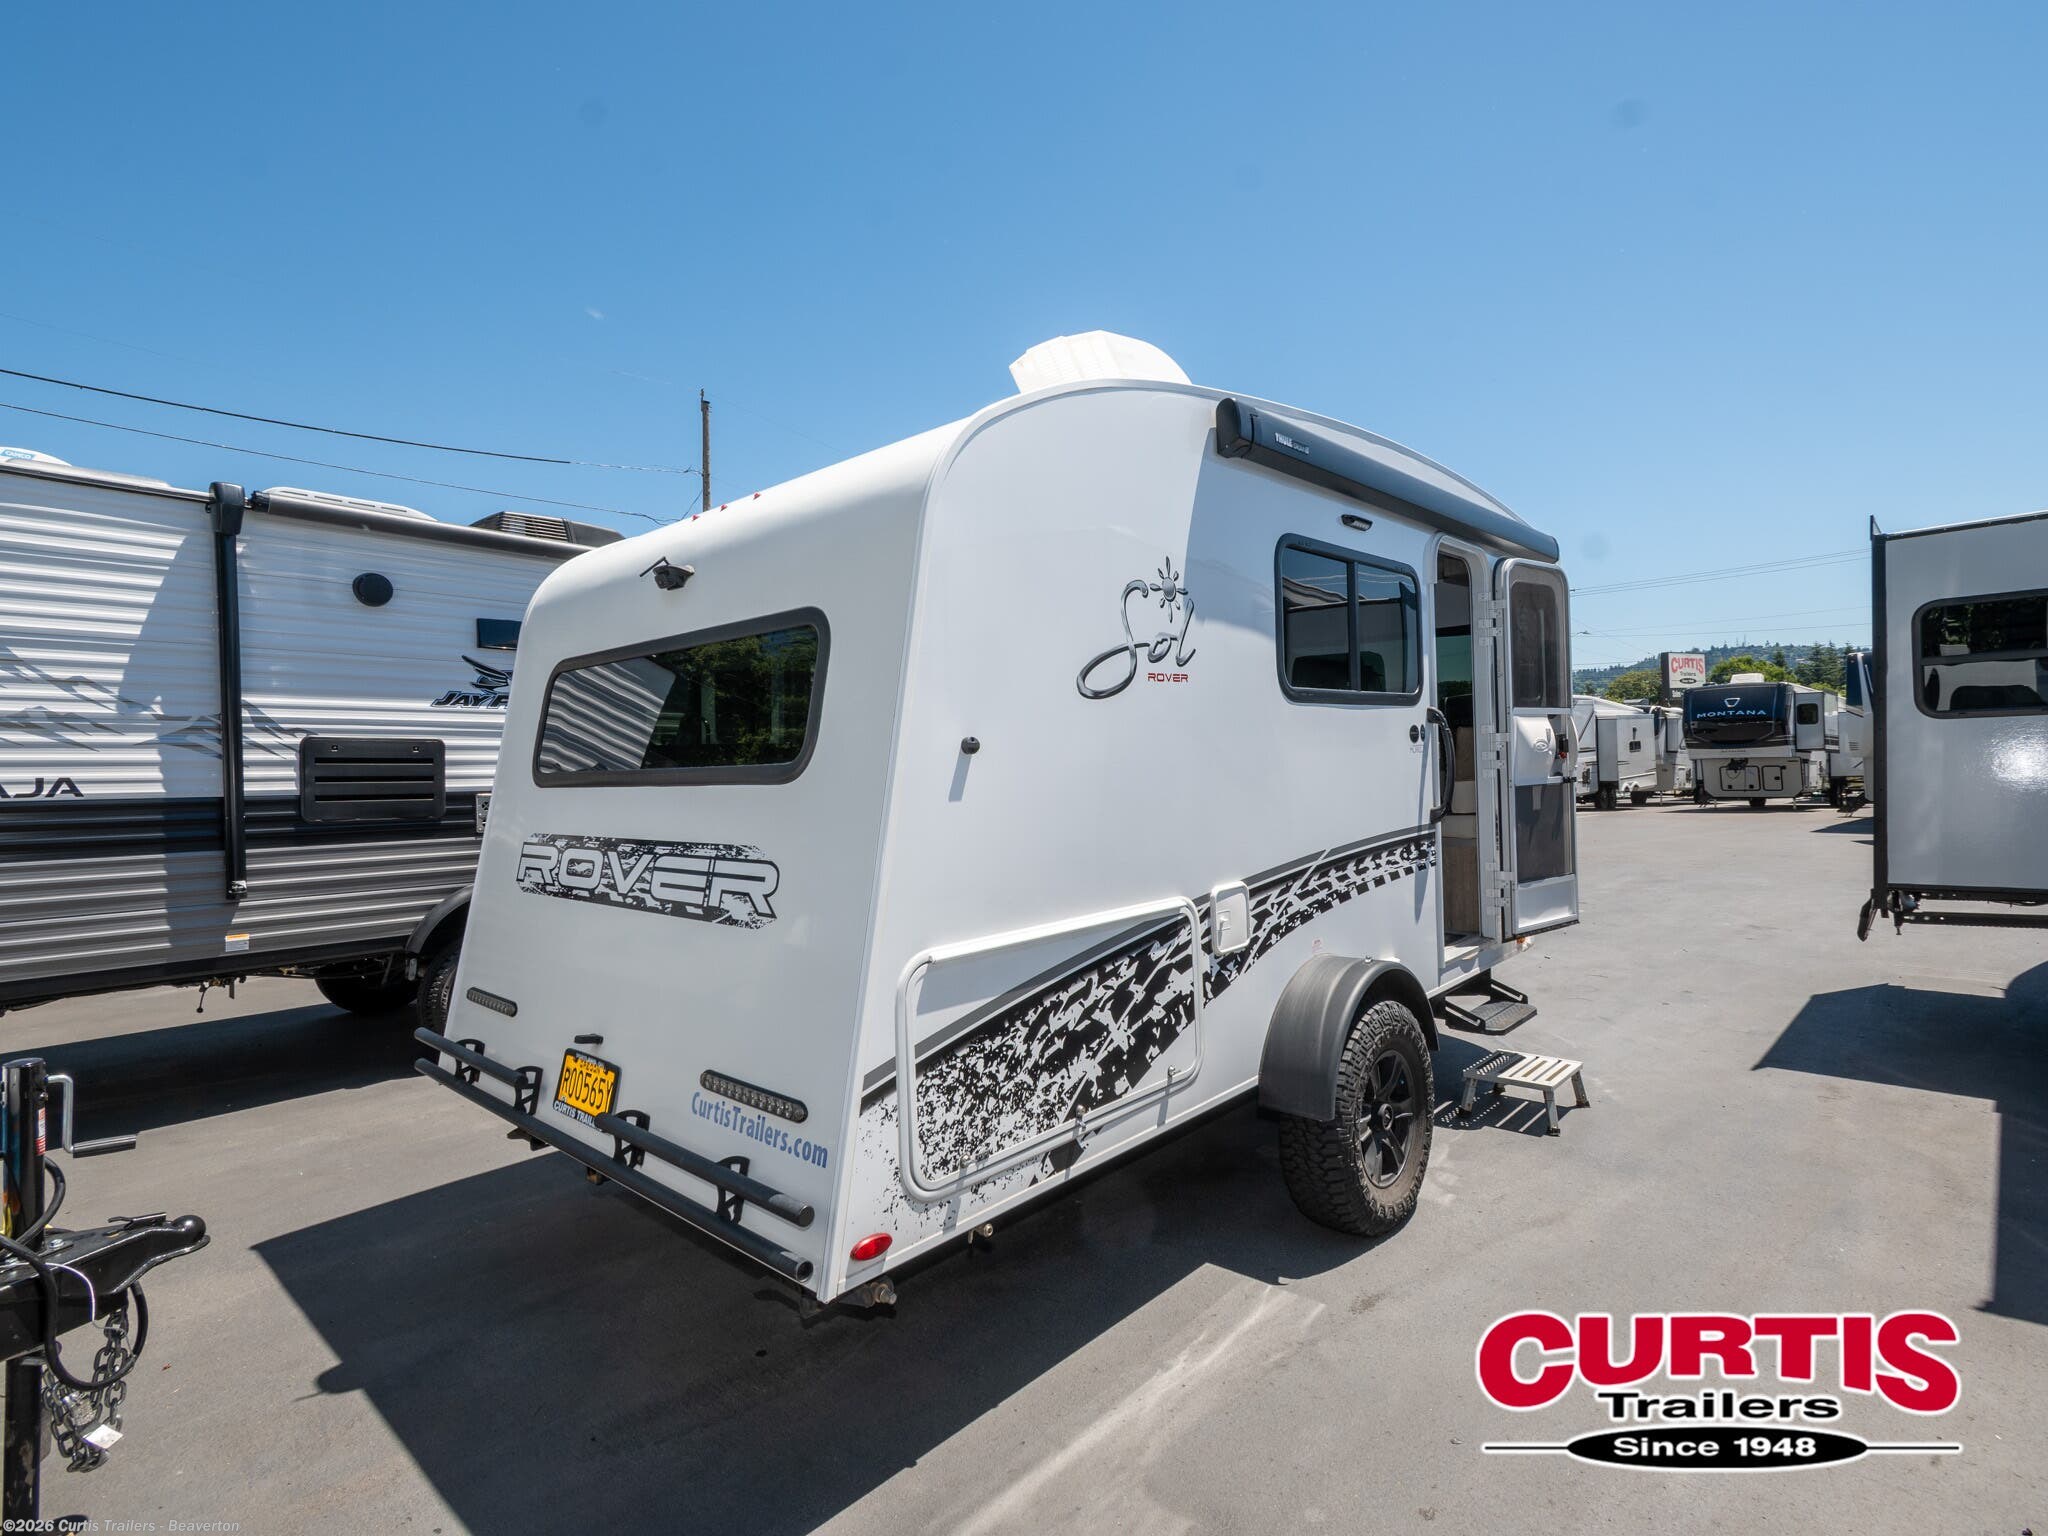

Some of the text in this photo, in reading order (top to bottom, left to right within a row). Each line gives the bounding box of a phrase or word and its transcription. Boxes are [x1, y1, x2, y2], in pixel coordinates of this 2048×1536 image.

[1671, 656, 1704, 674] CURTIS
[1148, 672, 1188, 683] ROVER
[1697, 710, 1767, 718] MONTANA
[0, 777, 84, 798] JA
[516, 842, 780, 919] ROVER
[561, 1067, 614, 1113] R00565Y
[554, 1101, 577, 1119] CURTIS
[691, 1091, 828, 1168] CurtisTrailers.com
